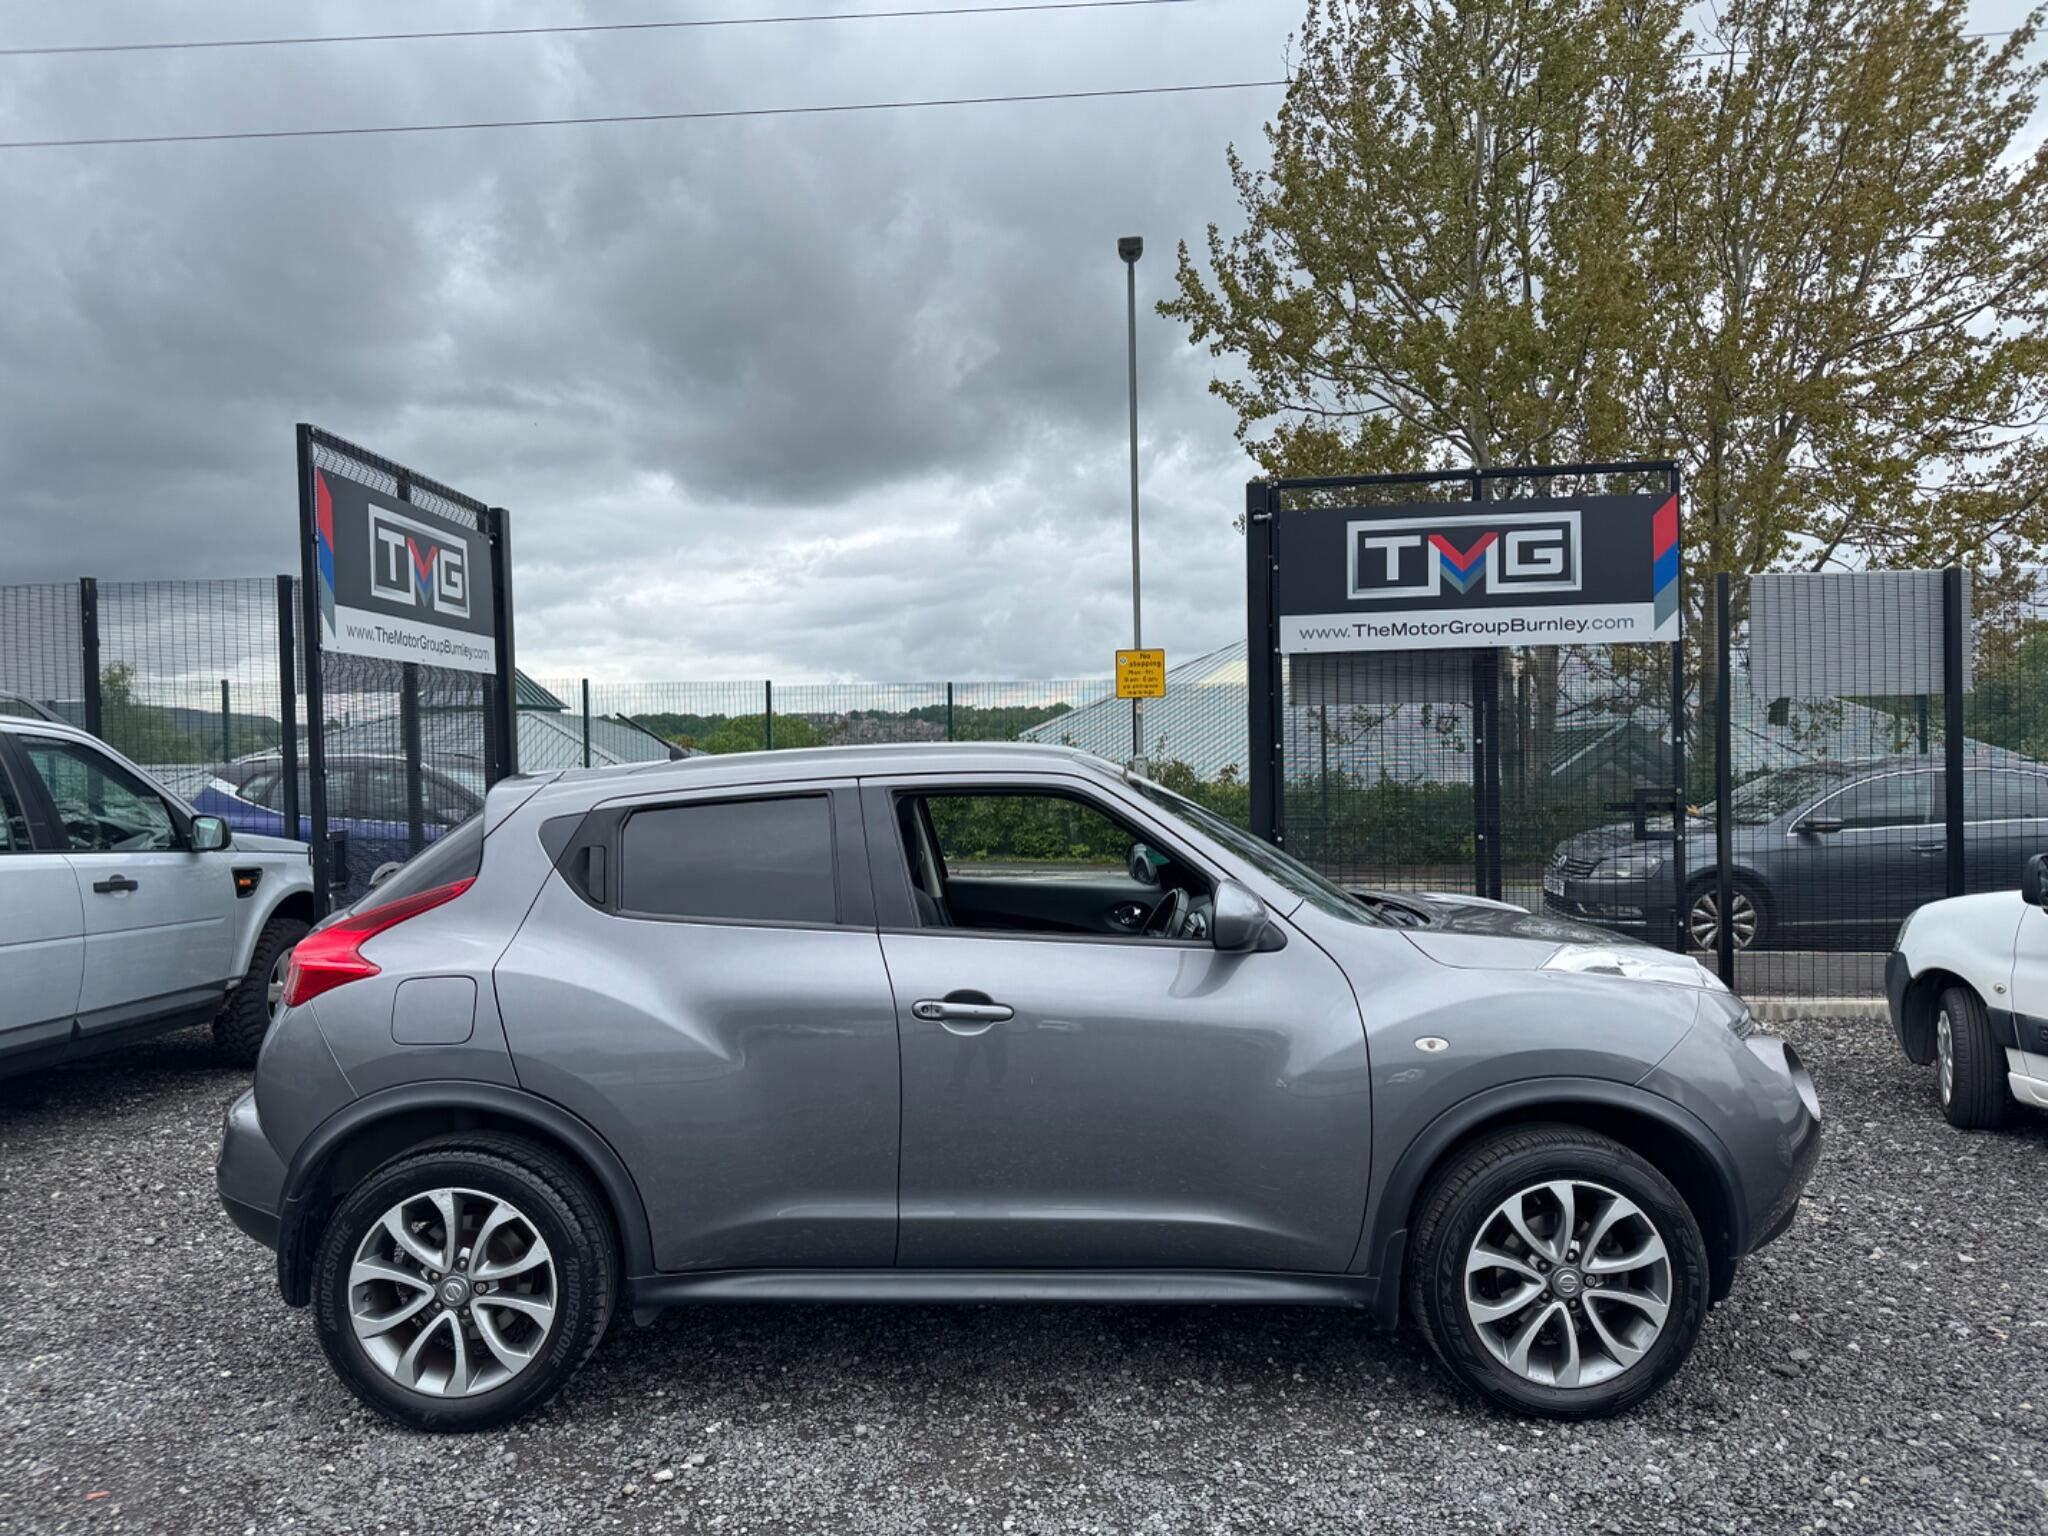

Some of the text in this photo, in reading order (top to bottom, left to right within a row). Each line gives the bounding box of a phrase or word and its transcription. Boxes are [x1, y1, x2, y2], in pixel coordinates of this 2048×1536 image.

[378, 527, 464, 607] TMG
[1364, 529, 1564, 595] TMG
[346, 624, 490, 661] www.TheMotorGroupBurnley.com
[1299, 616, 1635, 639] www.TheMotorGroupBurnley.com
[320, 1220, 355, 1333] BRIDGESTONE
[549, 1255, 585, 1369] BRIDGESTONE
